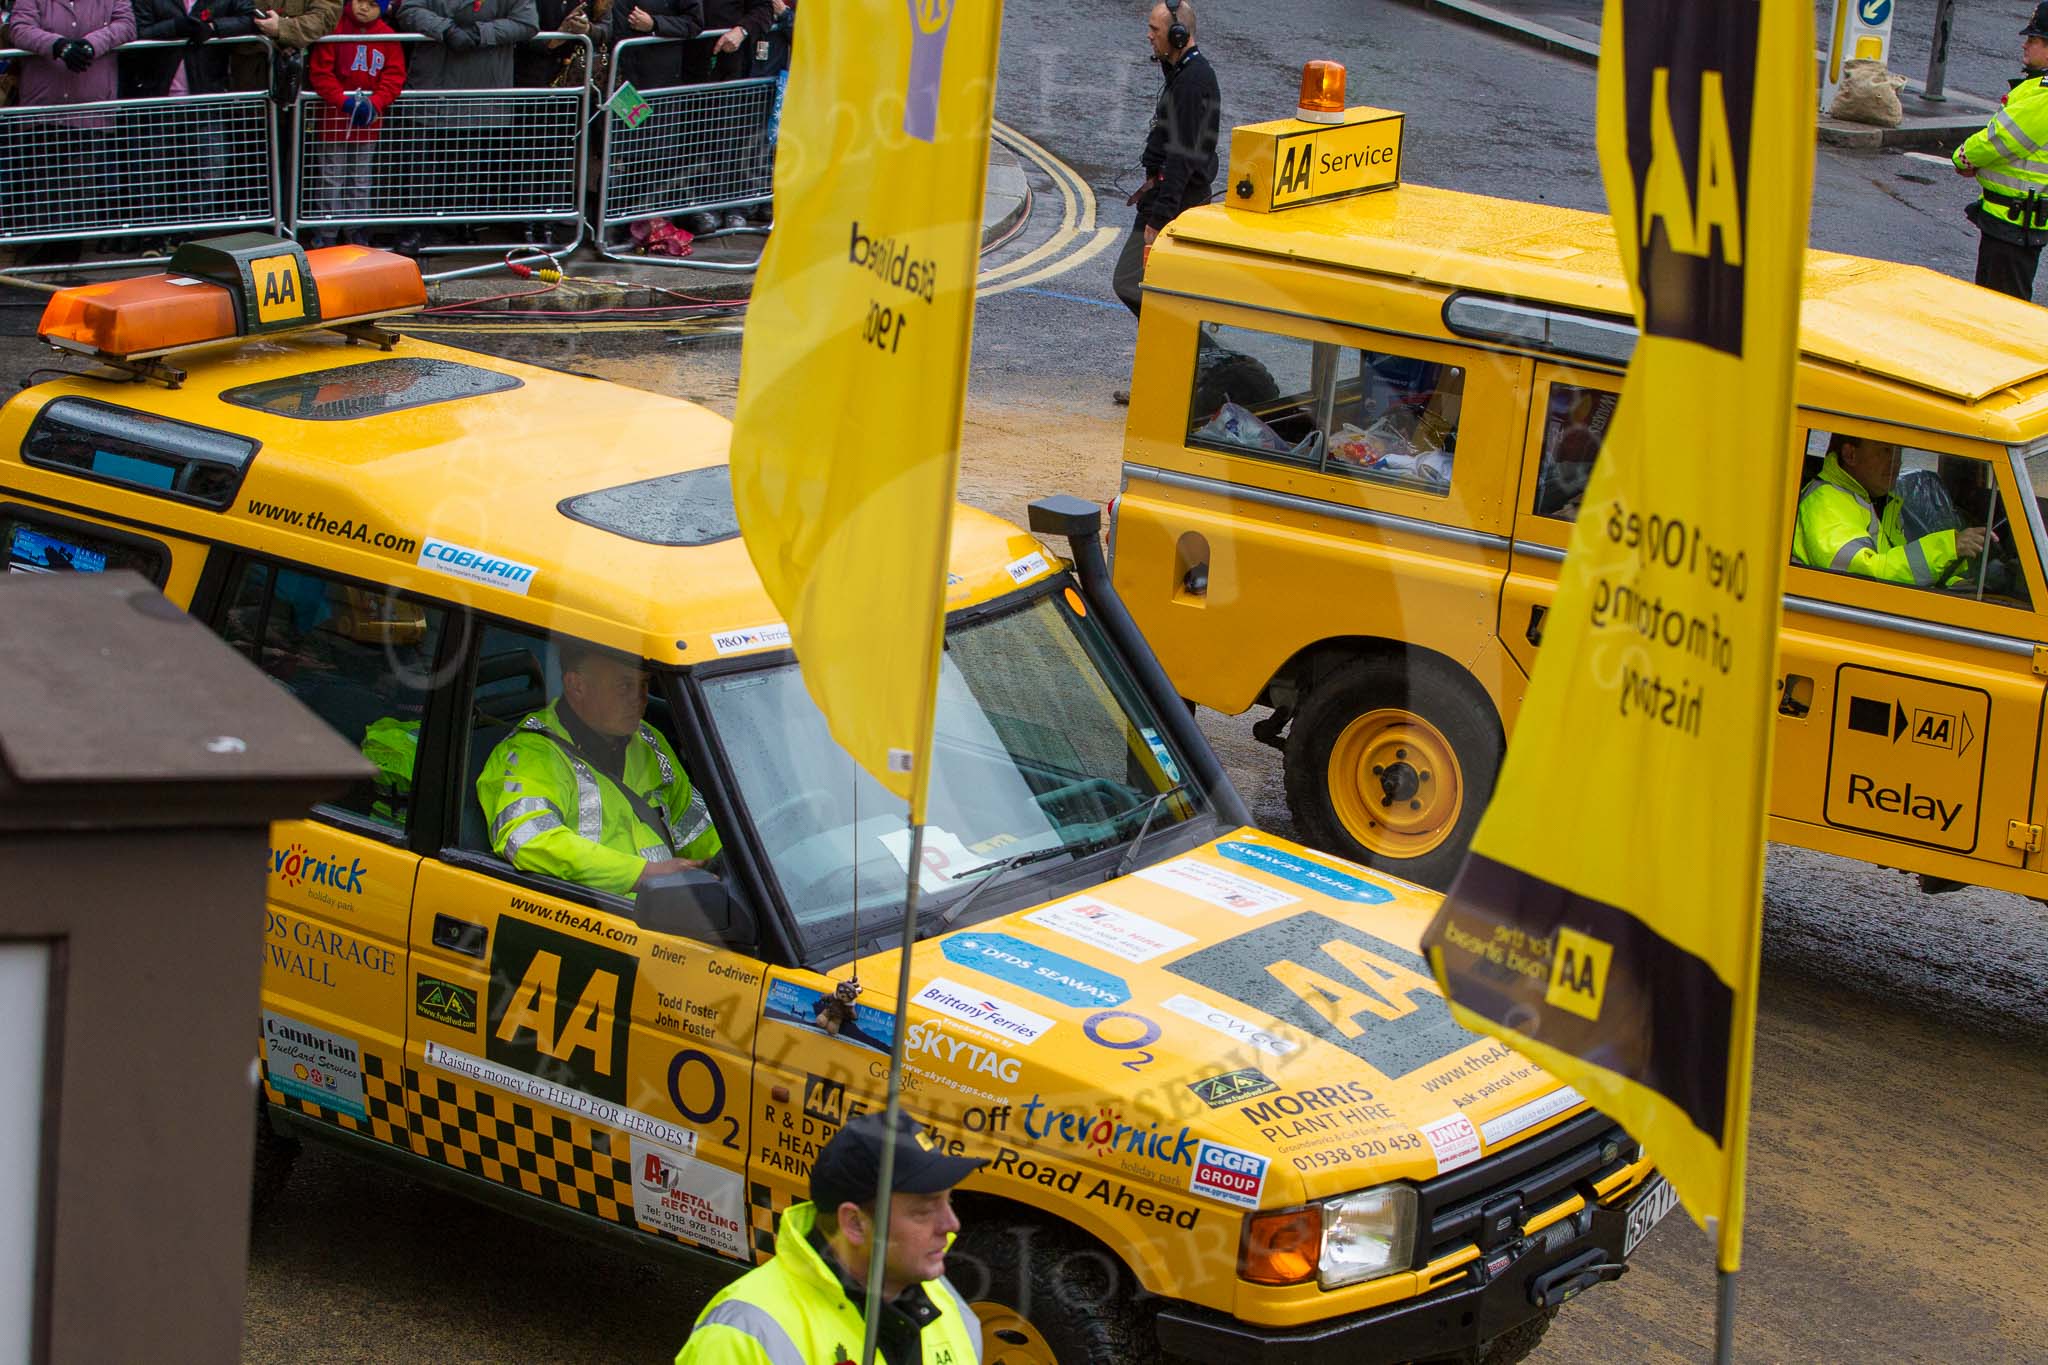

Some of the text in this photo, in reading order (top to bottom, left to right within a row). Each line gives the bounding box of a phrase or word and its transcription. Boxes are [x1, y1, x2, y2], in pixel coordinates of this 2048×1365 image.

[351, 45, 385, 76] AP
[1276, 143, 1393, 196] AA Service
[264, 269, 296, 306] AA
[247, 499, 416, 553] www.theAA.com
[423, 542, 533, 583] COBHAM
[717, 635, 743, 648] P&O
[1916, 716, 1950, 742] AA
[1848, 774, 1963, 832] Relay
[308, 888, 354, 913] holiday park
[510, 896, 638, 946] www.theAA.com
[294, 920, 396, 977] GARAGE
[651, 944, 685, 966] Driver:
[708, 959, 759, 987] Co-driver:
[982, 947, 1121, 1004] DFDS SEAWAYS
[1263, 938, 1440, 1041] AA
[496, 950, 620, 1076] AA
[655, 1011, 716, 1039] John Foster
[658, 992, 719, 1020] Todd Foster
[923, 987, 985, 1018] Brittany
[984, 1012, 1038, 1039] Ferries
[267, 1019, 356, 1063] Cambrian
[269, 1038, 357, 1079] FuelCard Services
[907, 1024, 1022, 1084] SKYTAG
[438, 1050, 684, 1146] Raising money for HELP FOR HEROES
[806, 1081, 841, 1120] AA
[1241, 1081, 1374, 1126] MORRIS
[1452, 1091, 1477, 1109] Ask
[1478, 1075, 1514, 1099] patrol
[1514, 1066, 1531, 1081] for
[765, 1104, 775, 1123] R
[782, 1112, 794, 1130] &
[802, 1119, 814, 1135] D
[963, 1105, 1012, 1133] Off
[1021, 1093, 1199, 1168] trevornick
[1261, 1103, 1397, 1143] PLANT HIRE
[1429, 1119, 1473, 1147] UNIC
[1204, 1147, 1260, 1176] GGR
[1292, 1133, 1422, 1171] 01938 820 458
[992, 1147, 1082, 1195] Road
[1086, 1179, 1200, 1231] Ahead
[1120, 1158, 1182, 1187] holiday park
[1200, 1167, 1256, 1192] GROUP
[661, 1196, 739, 1232] RECYCLING
[671, 1188, 714, 1213] METAL
[646, 1204, 733, 1241] Tel: 0118 978 5143
